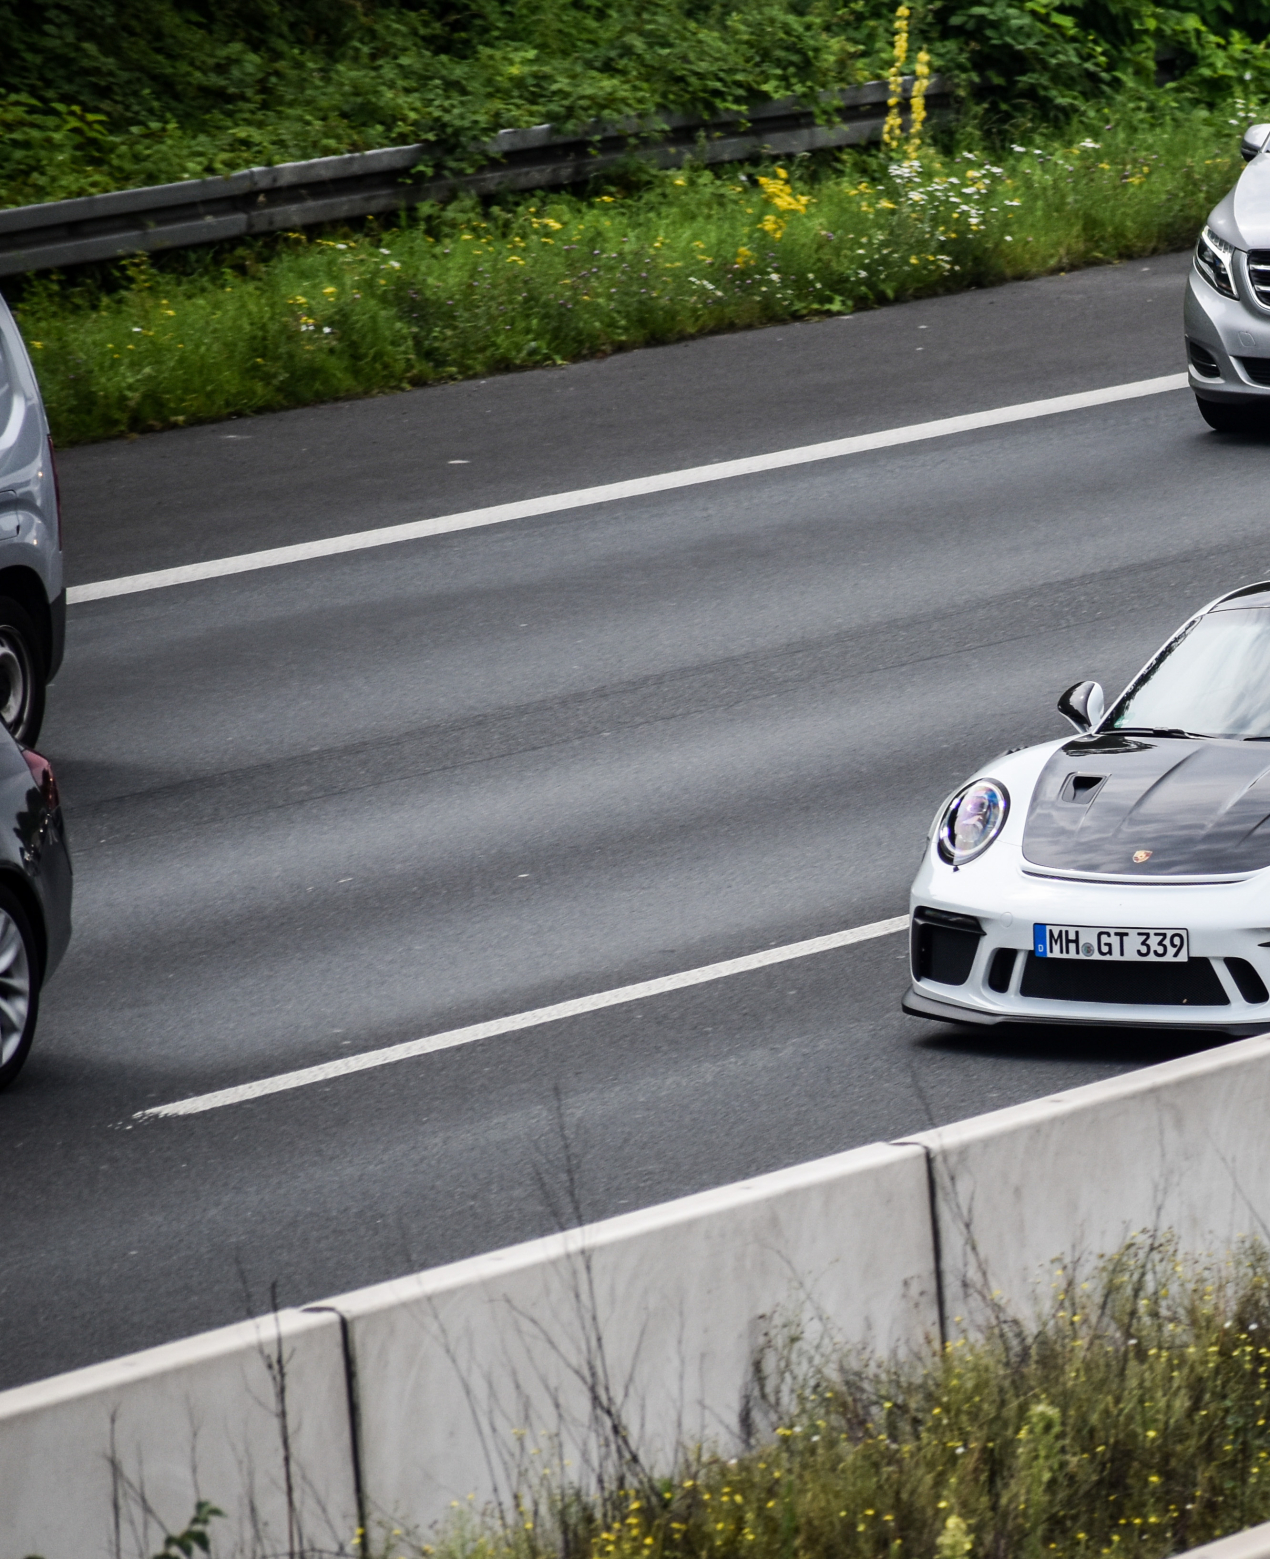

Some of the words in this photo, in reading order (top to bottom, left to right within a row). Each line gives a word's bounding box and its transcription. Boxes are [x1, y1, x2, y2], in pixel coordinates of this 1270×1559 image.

[1038, 944, 1044, 952] D
[1048, 928, 1080, 955] MH
[1097, 931, 1129, 957] GT
[1136, 932, 1185, 958] 339
